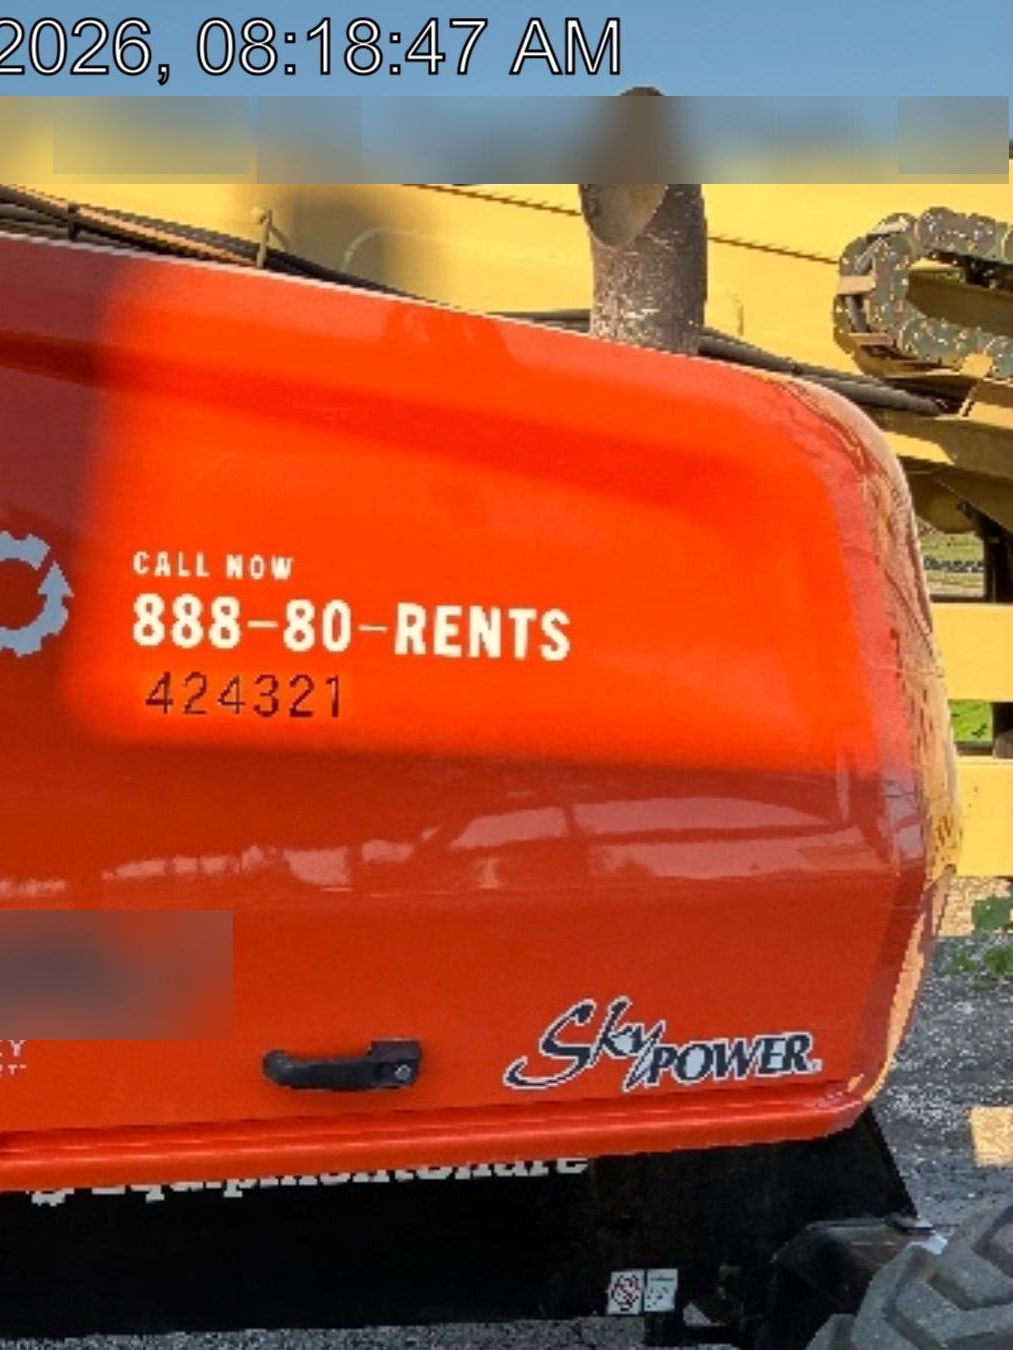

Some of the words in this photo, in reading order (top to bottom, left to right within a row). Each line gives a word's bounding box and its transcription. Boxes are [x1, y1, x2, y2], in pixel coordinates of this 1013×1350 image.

[133, 550, 210, 577] CALL
[226, 554, 294, 580] NOW
[132, 593, 571, 662] 888-80-RENTS
[145, 672, 343, 718] 424321
